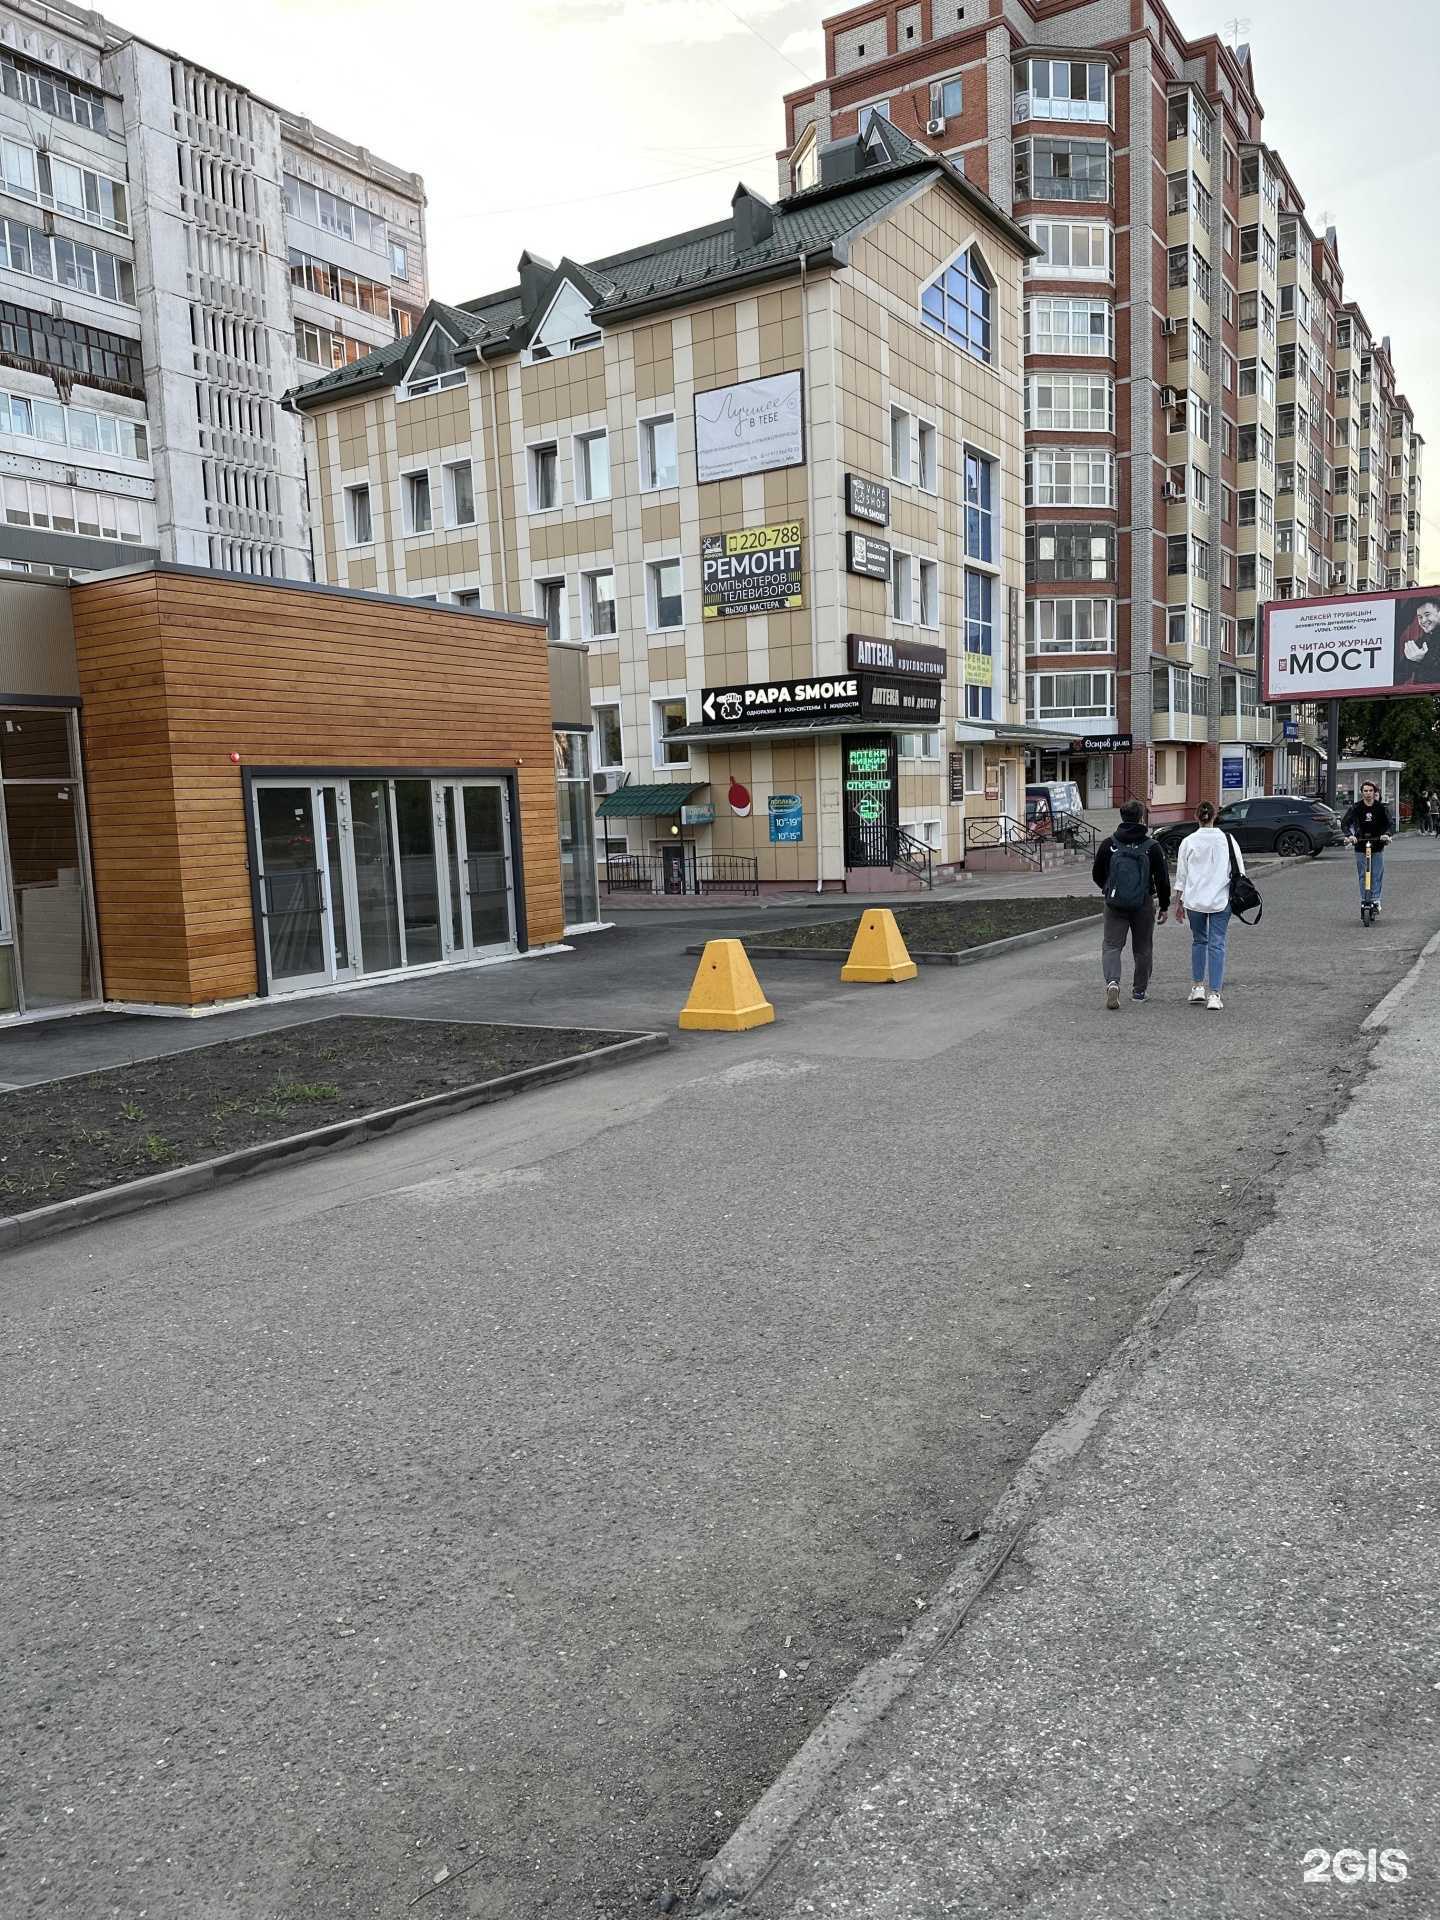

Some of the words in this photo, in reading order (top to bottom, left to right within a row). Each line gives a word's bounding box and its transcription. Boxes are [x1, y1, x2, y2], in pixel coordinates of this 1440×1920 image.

[749, 417, 756, 428] В
[758, 411, 779, 425] ТЕБЕ
[866, 483, 886, 500] VAPE
[866, 494, 886, 510] SHOP
[854, 503, 869, 516] PAPA
[868, 508, 886, 522] SMOKE
[740, 525, 800, 551] 220-788
[703, 546, 801, 581] РЕМОНТ
[704, 572, 787, 593] КОМПЬЮТЕРОВ
[722, 582, 801, 602] ТЕЛЕВИЗОРОВ
[725, 604, 748, 615] ВЫЗОВ
[749, 600, 780, 612] МАСТЕРА
[1300, 612, 1332, 622] АЛЕКСЕЙ
[1333, 609, 1372, 618] ТРУБИЦЫН
[1290, 644, 1297, 652] Я
[1299, 641, 1336, 651] ЧИТАЮ
[1338, 637, 1383, 648] ЖУРНАЛ
[857, 640, 894, 668] АПТЕКА
[1289, 646, 1382, 675] МОСТ
[744, 687, 792, 705] PAPA
[794, 680, 858, 702] SMOKE
[871, 687, 900, 706] АПТЕКА
[849, 750, 888, 759] АПТЕКА
[857, 763, 878, 771] ЦЕН
[846, 780, 891, 791] ОТКРЫТО
[860, 799, 879, 813] 24
